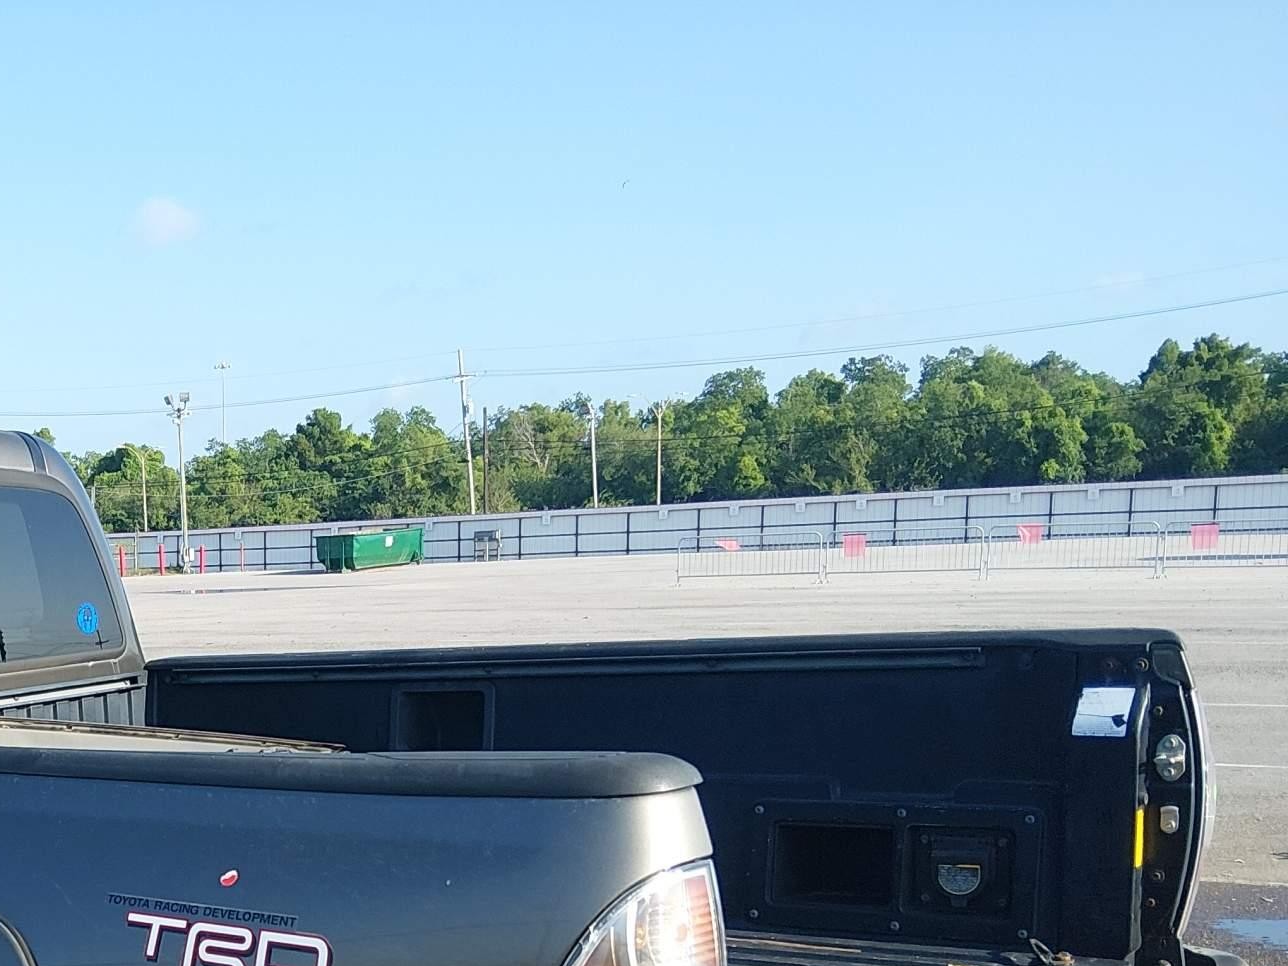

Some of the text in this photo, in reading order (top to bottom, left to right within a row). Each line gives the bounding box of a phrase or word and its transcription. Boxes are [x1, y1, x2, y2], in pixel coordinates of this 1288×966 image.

[108, 894, 297, 928] TOYOTA RACING DEVELOPMENT
